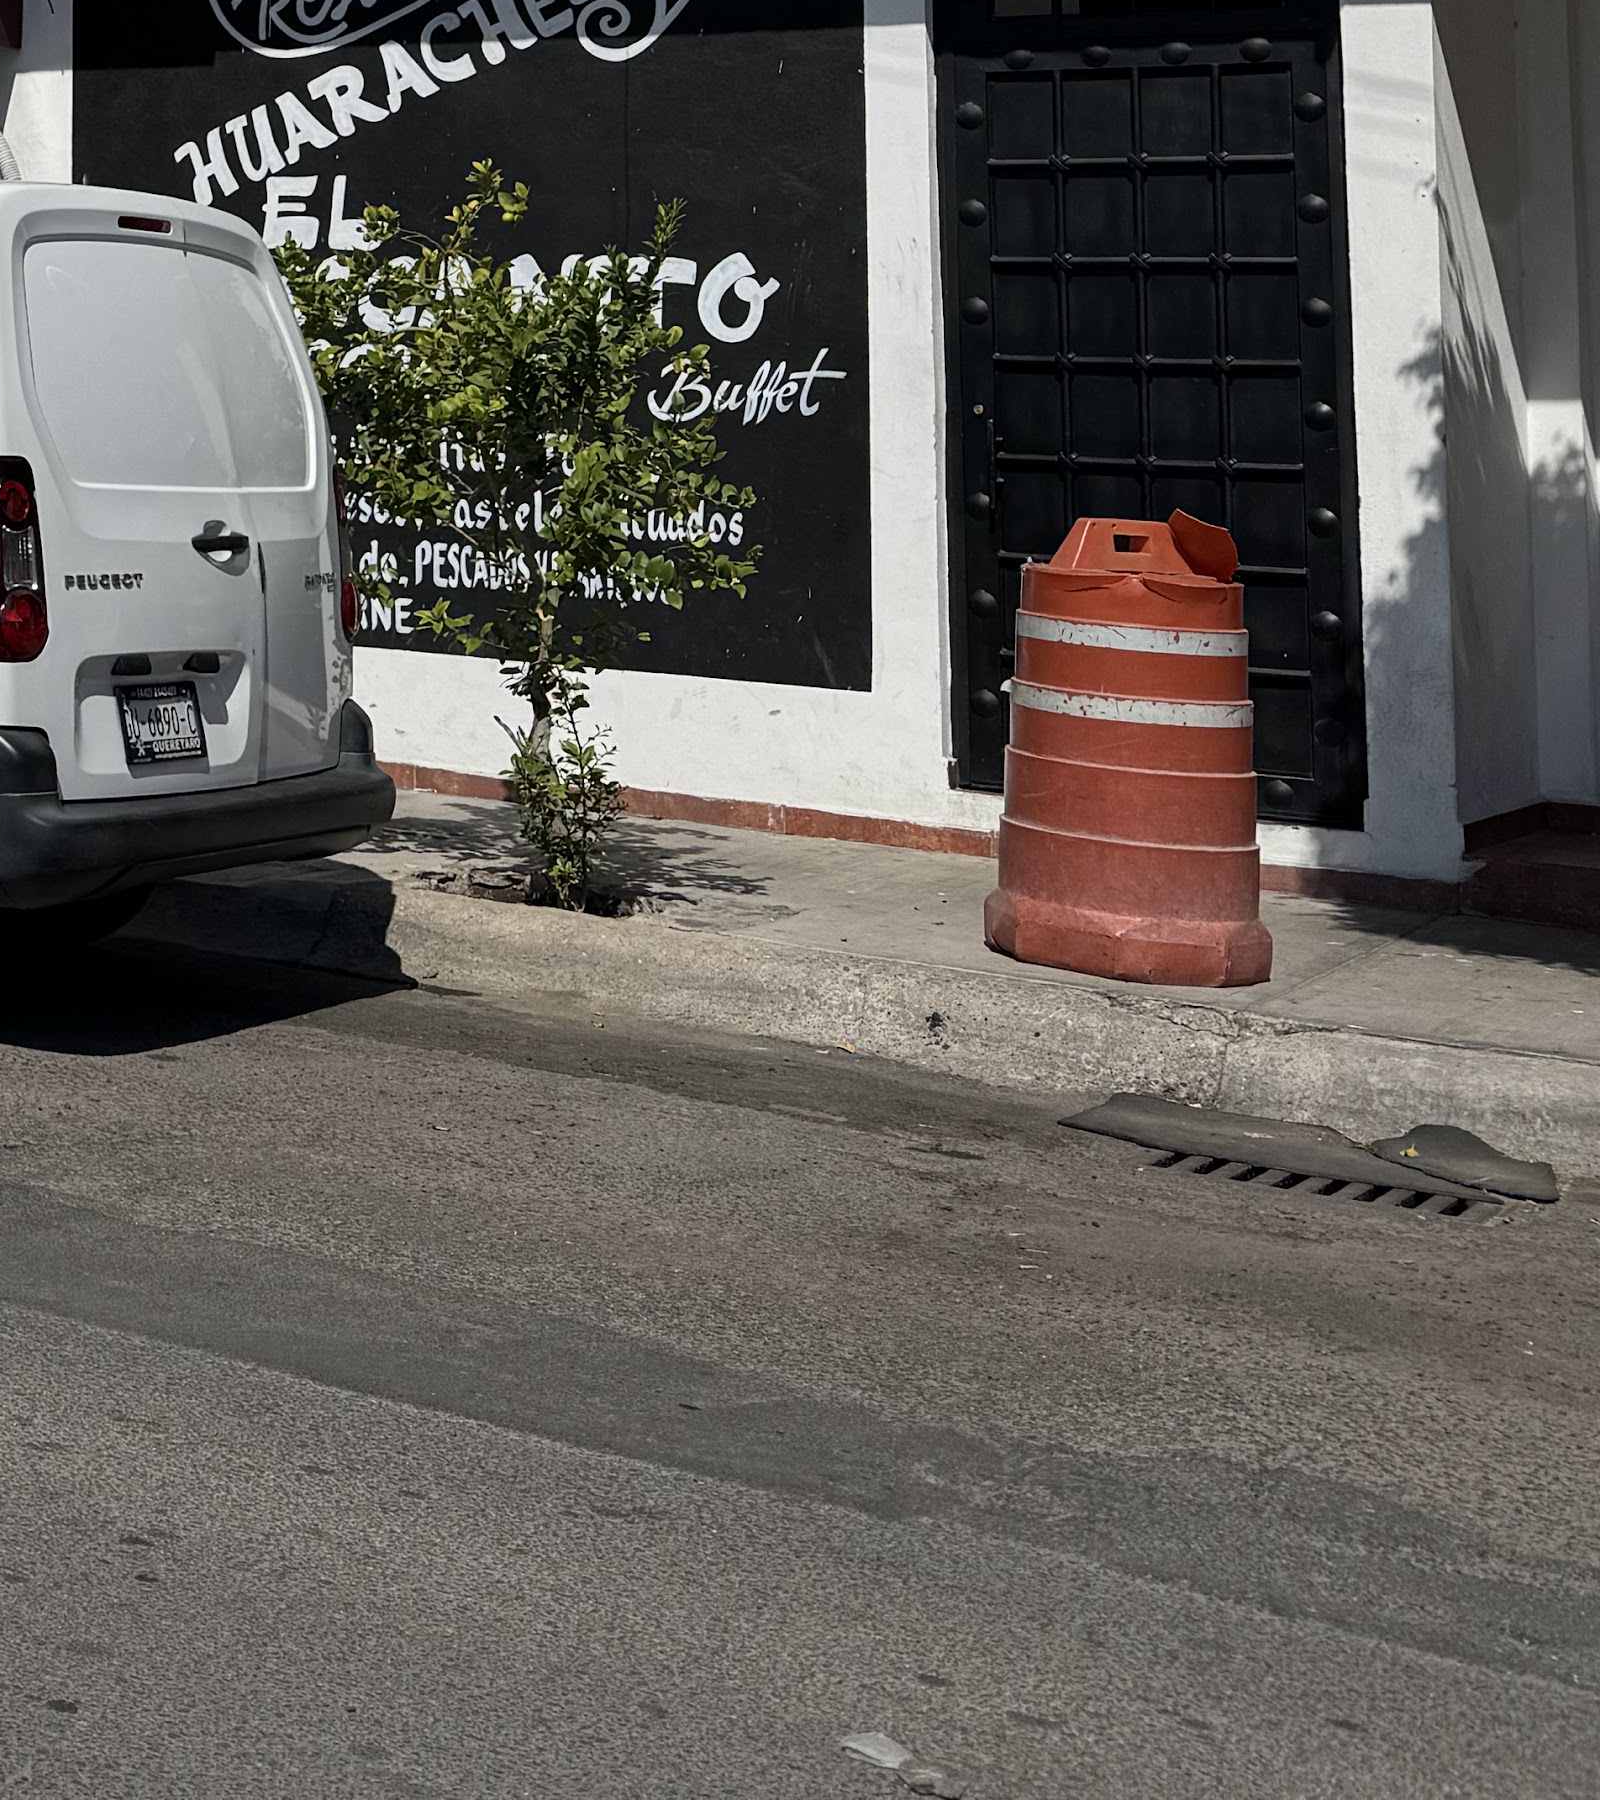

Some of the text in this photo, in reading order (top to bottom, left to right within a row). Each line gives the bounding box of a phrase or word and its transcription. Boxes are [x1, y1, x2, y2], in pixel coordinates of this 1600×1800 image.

[262, 174, 390, 252] EL
[647, 347, 848, 426] Buffet
[64, 573, 144, 592] PEUGEOT
